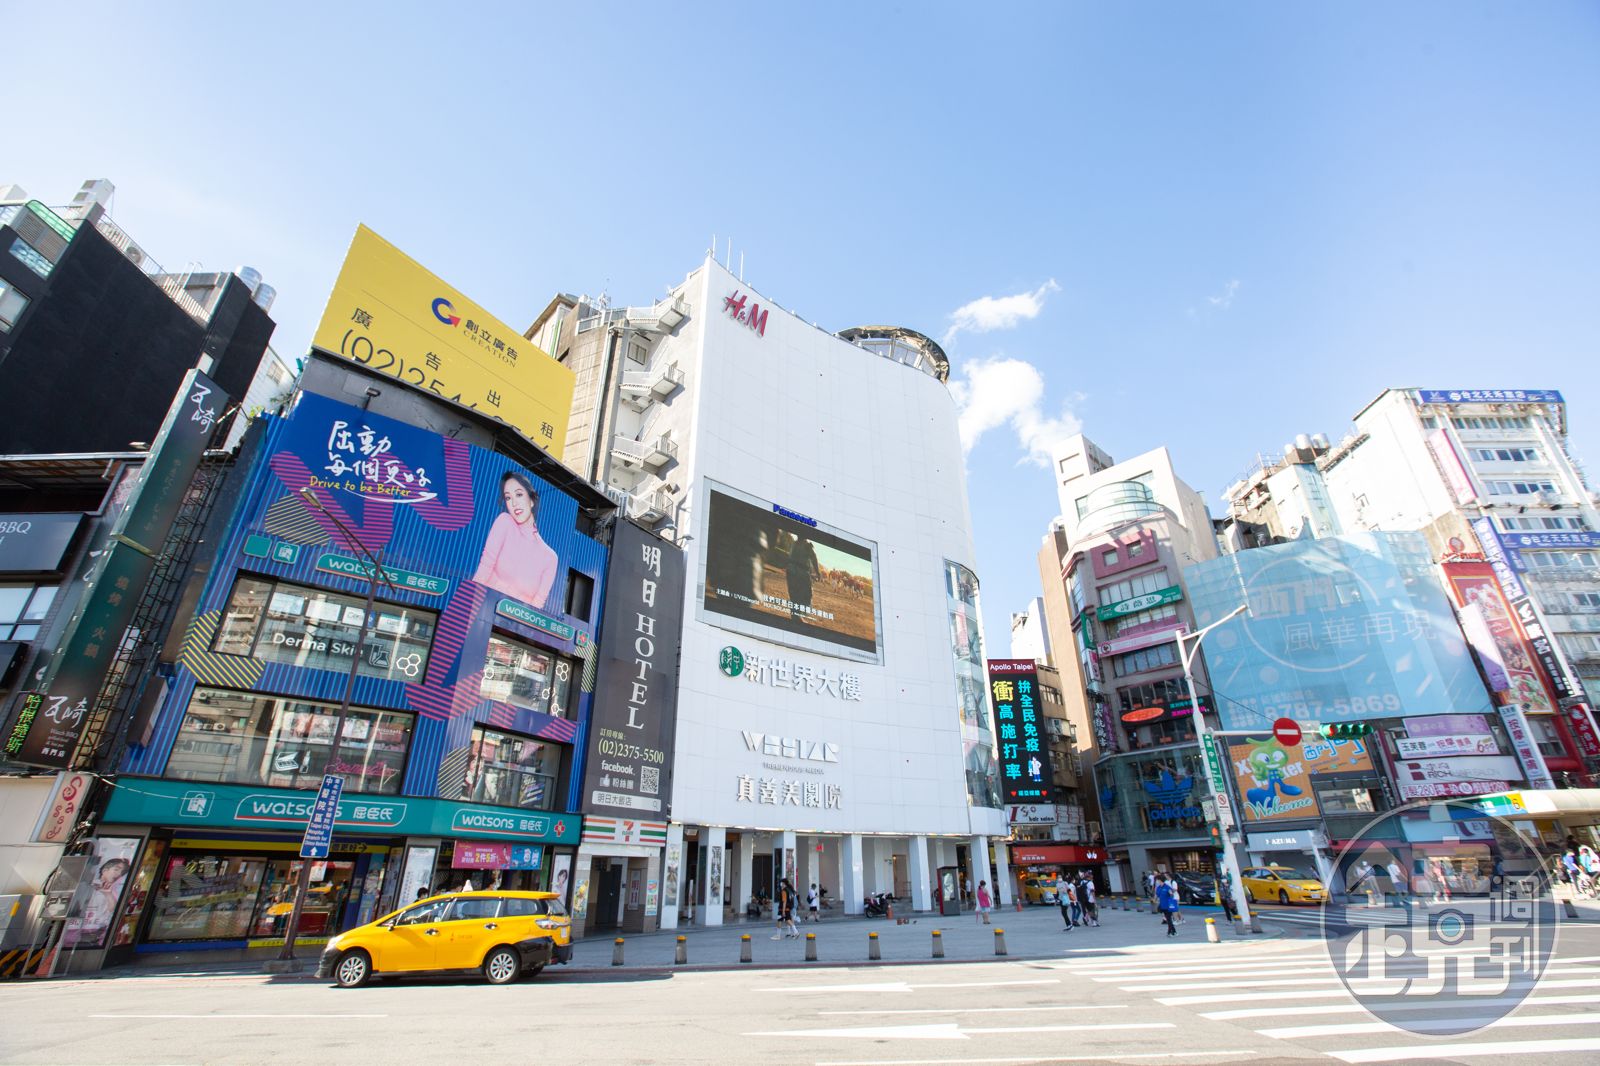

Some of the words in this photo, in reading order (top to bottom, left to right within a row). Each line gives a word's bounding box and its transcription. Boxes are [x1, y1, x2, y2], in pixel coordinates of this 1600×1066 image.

[725, 290, 768, 337] H&M
[463, 330, 516, 368] CREATION
[465, 319, 518, 361] 創立廣告
[310, 475, 341, 489] Drive
[345, 480, 355, 491] to
[360, 482, 373, 492] be
[377, 484, 411, 496] Better
[324, 452, 431, 488] 每個更好
[773, 504, 817, 527] Panasonic
[329, 558, 398, 581] watsons
[406, 575, 438, 590] 屈臣氏
[642, 544, 661, 607] 明日
[506, 604, 546, 627] watsons
[1285, 610, 1437, 654] 風華再現
[273, 632, 326, 652] Derma
[626, 613, 656, 729] HOTEL
[743, 652, 863, 701] 新世界大樓
[992, 681, 1022, 780] 衝高施打率
[598, 738, 664, 764] (02)2375-5500
[737, 774, 842, 809] 真善美劇院
[1243, 795, 1313, 819] Welcome
[252, 801, 342, 818] watsos
[353, 805, 394, 821] 屈臣氏
[462, 814, 514, 830] watsons
[519, 819, 543, 832] 屈臣氏
